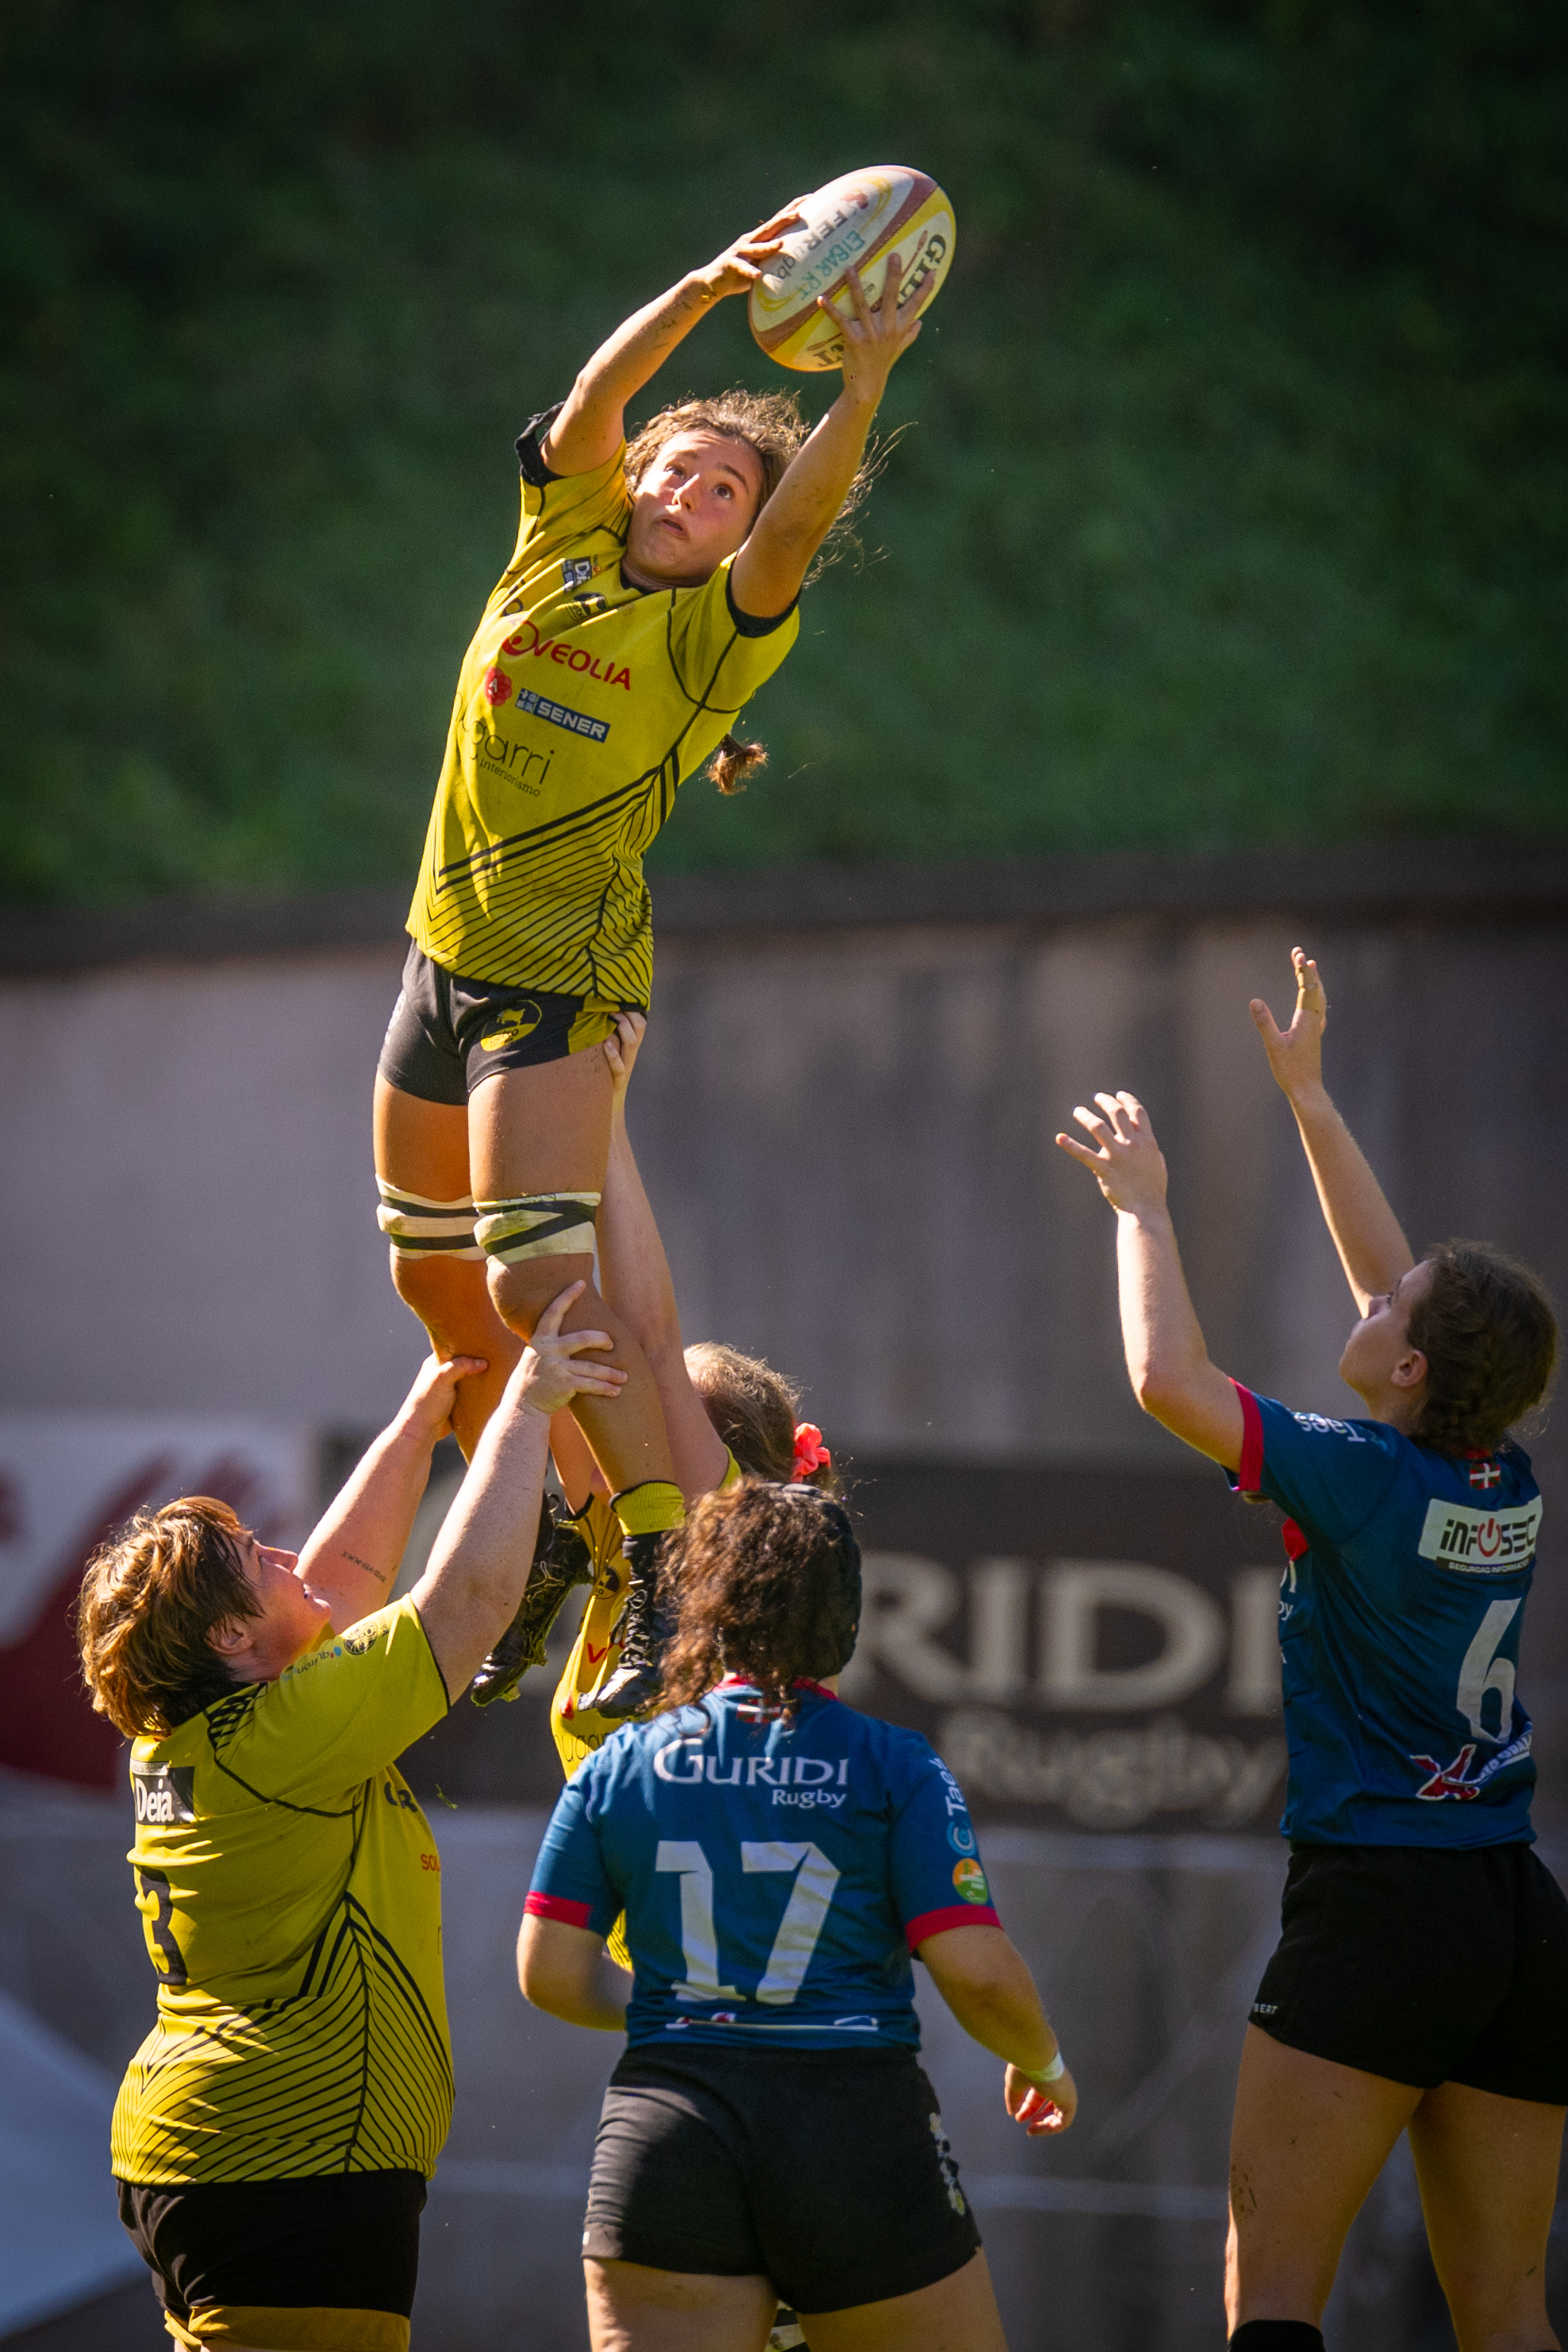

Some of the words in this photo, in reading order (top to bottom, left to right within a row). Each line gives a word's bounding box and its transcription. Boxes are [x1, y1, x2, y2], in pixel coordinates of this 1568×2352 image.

[534, 639, 632, 691] VEOLIA
[537, 701, 606, 740] SENER
[479, 758, 541, 797] interiorismo
[843, 1551, 1280, 1718] RIDI
[1456, 1597, 1523, 1744] 6
[135, 1777, 175, 1823] Deia
[772, 1788, 847, 1808] Rugby
[139, 1867, 189, 1985] 3
[655, 1839, 841, 2005] 17
